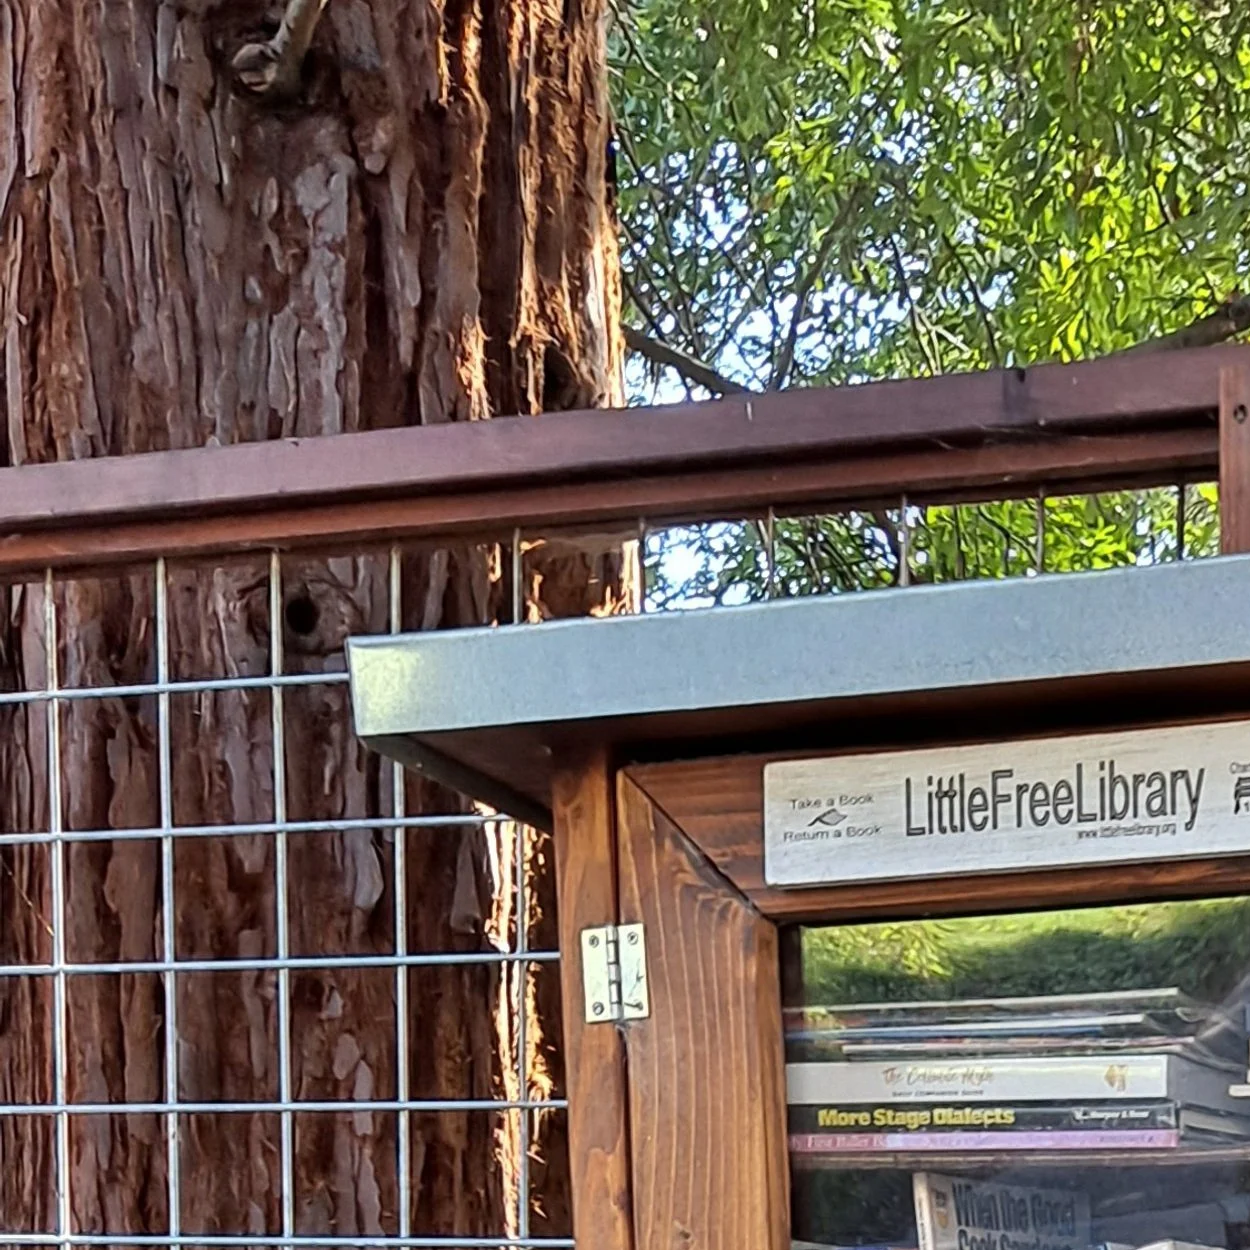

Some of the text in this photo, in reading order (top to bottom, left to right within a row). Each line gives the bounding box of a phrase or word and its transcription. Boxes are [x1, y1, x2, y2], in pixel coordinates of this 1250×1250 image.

[791, 795, 874, 810] Take a Book
[905, 761, 1205, 837] LittleFreeLibrary
[783, 825, 882, 842] Return a Book
[818, 1106, 1015, 1129] More Stage Dialects
